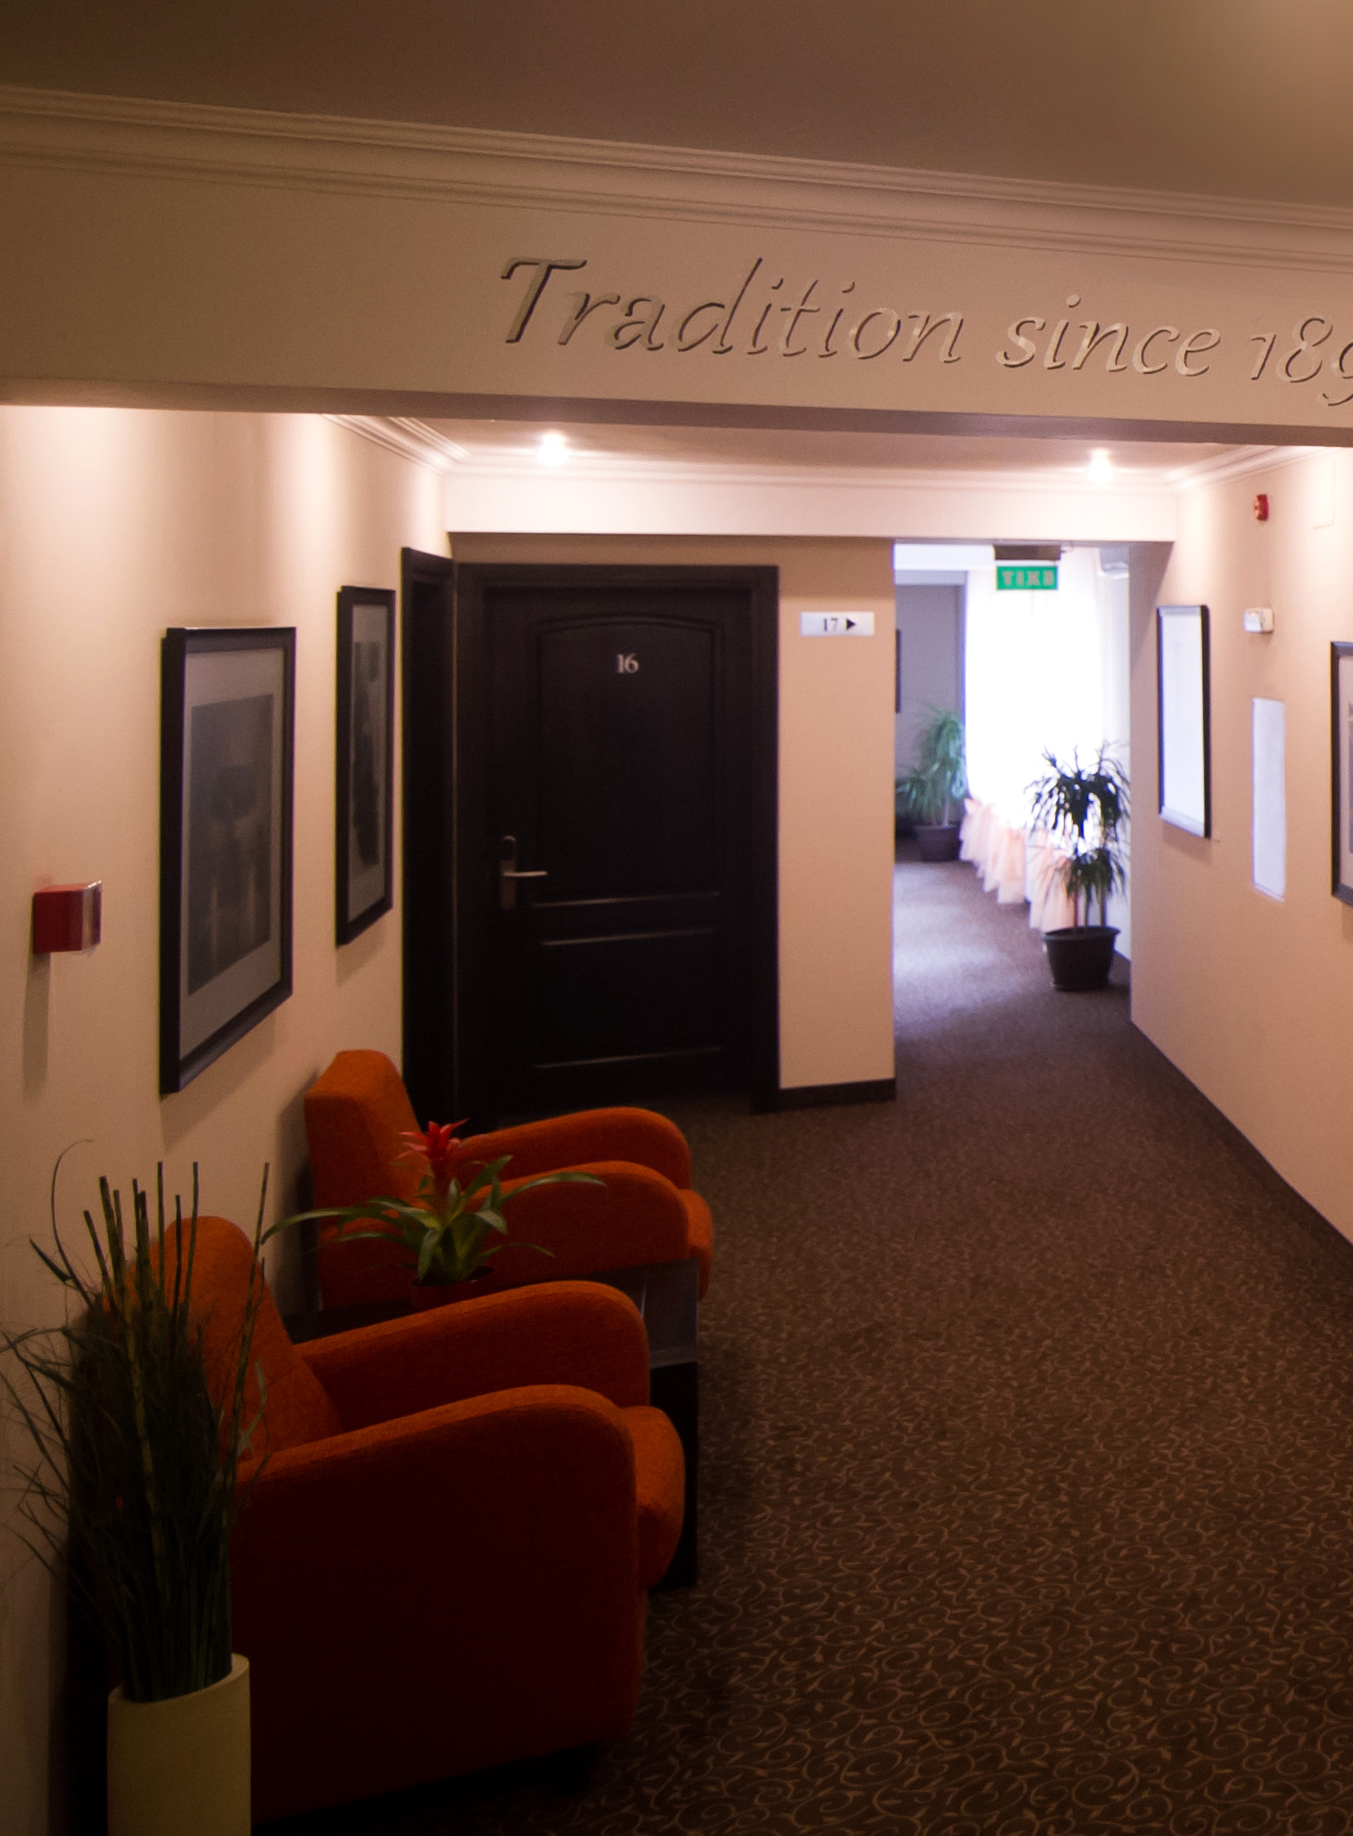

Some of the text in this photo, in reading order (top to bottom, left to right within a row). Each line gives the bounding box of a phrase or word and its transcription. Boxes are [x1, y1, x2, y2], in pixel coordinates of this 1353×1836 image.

[499, 255, 963, 366] Tradition
[994, 294, 1220, 376] since
[822, 617, 839, 632] 17
[617, 652, 640, 674] 16
